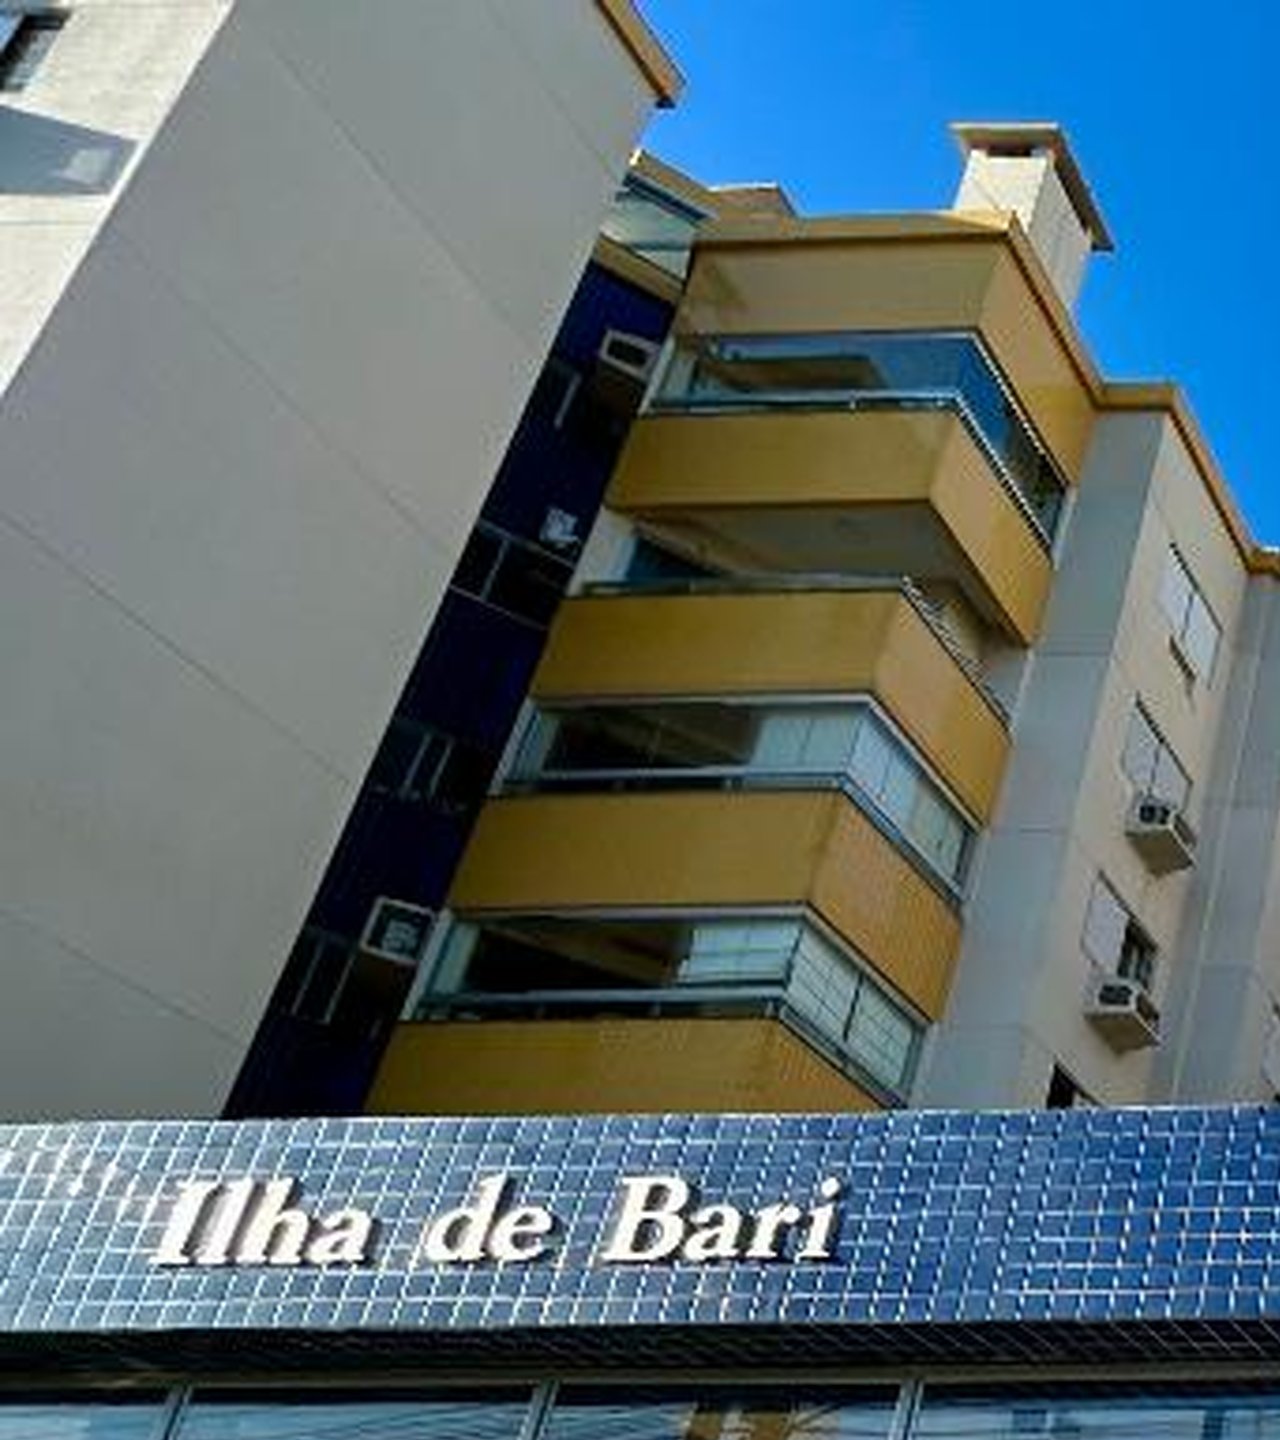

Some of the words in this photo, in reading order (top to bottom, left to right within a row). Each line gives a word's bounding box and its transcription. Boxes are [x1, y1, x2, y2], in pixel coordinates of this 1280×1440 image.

[149, 1177, 375, 1265] Ilha
[424, 1174, 553, 1265] de
[600, 1175, 841, 1263] Bari
